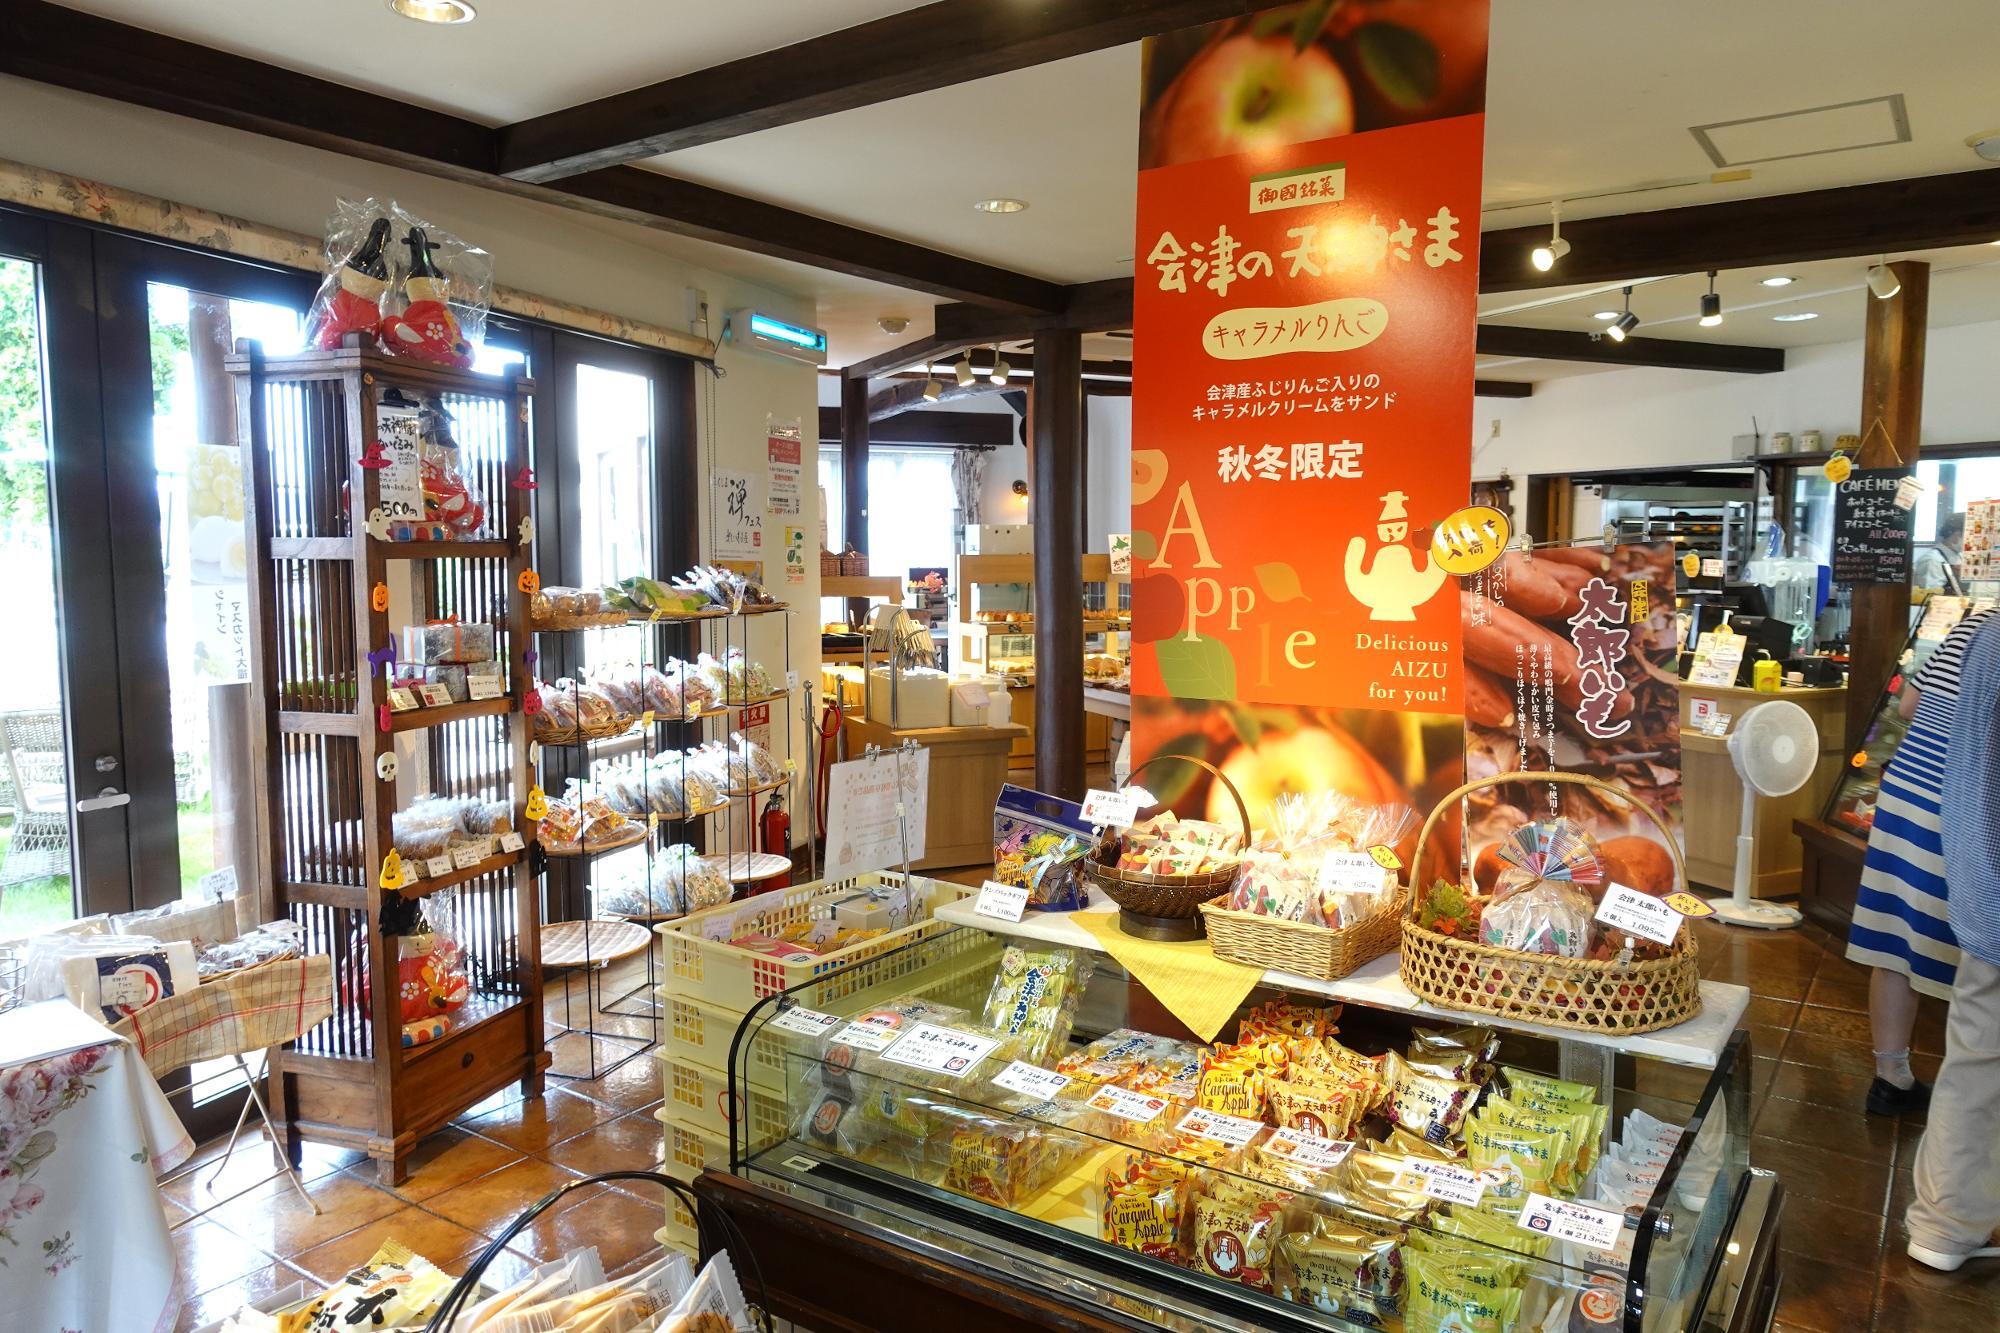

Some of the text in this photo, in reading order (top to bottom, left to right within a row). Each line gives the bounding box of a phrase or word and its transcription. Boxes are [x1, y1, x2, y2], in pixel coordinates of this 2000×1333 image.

[1212, 308, 1377, 349] キャラメルりんご
[1206, 372, 1381, 402] 会津産ふじりんご入りの
[1191, 391, 1398, 422] キャラメルクリームをサンド
[1216, 439, 1365, 484] 秋冬限定
[1354, 633, 1450, 654] Delicious
[1390, 660, 1449, 679] AIZU
[1368, 682, 1448, 705] for you!
[1618, 893, 1636, 905] 会津
[1202, 1076, 1248, 1098] Caramel
[1111, 1198, 1157, 1226] Caramel
[1133, 1215, 1169, 1244] Apple
